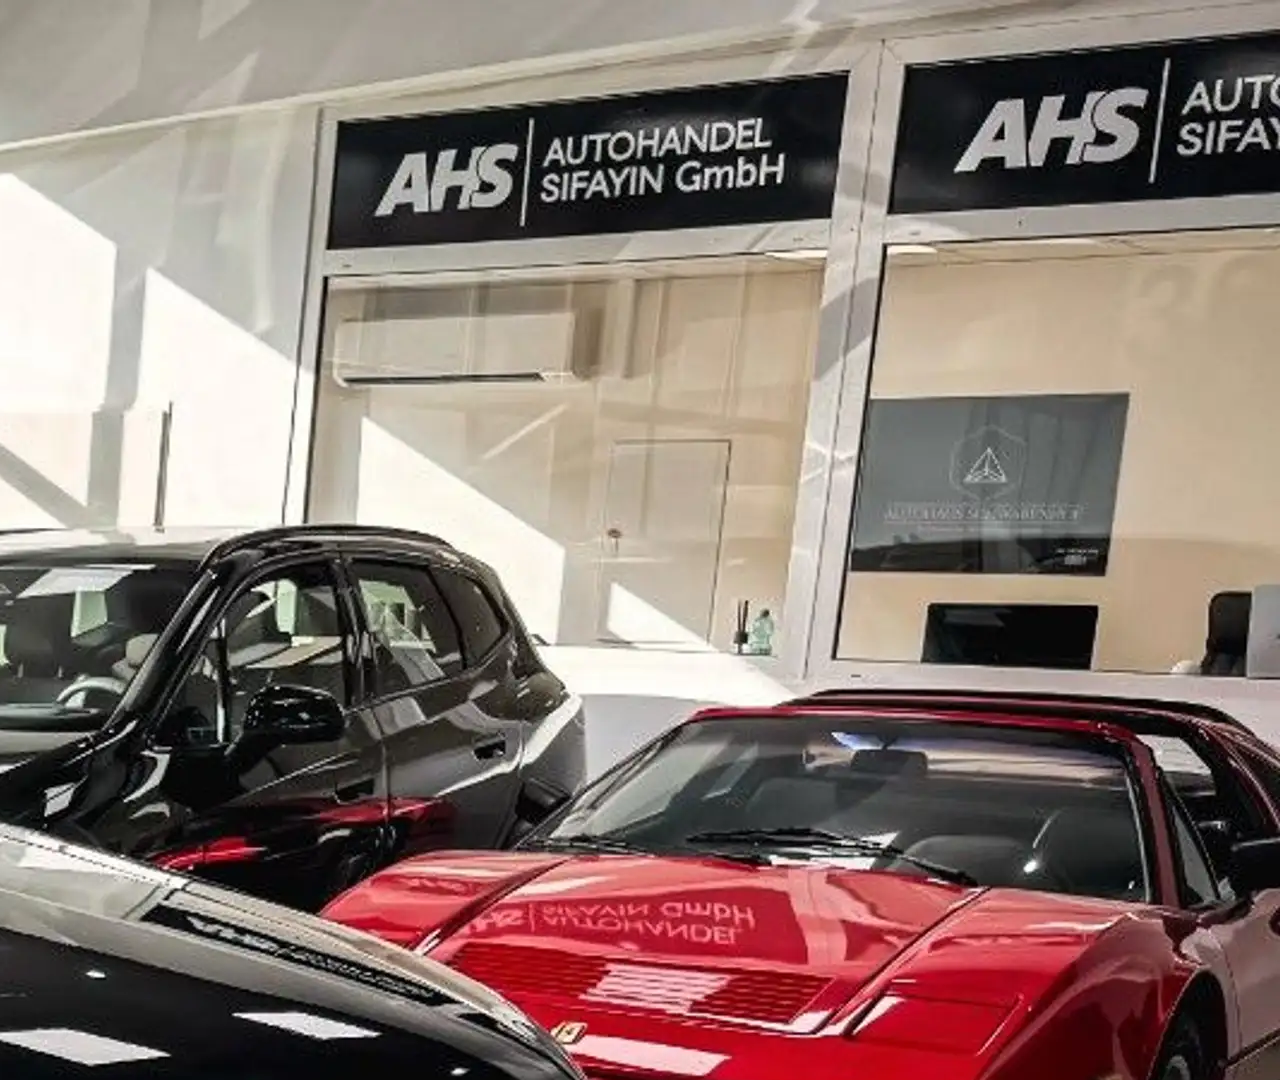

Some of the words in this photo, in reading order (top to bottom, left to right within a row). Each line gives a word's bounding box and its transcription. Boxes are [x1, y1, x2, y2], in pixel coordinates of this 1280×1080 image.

[543, 117, 773, 168] AUTOHANDEL
[953, 87, 1149, 173] AHS
[374, 143, 519, 217] AHS
[540, 163, 665, 204] SIFAYIN
[675, 154, 785, 193] GmbH
